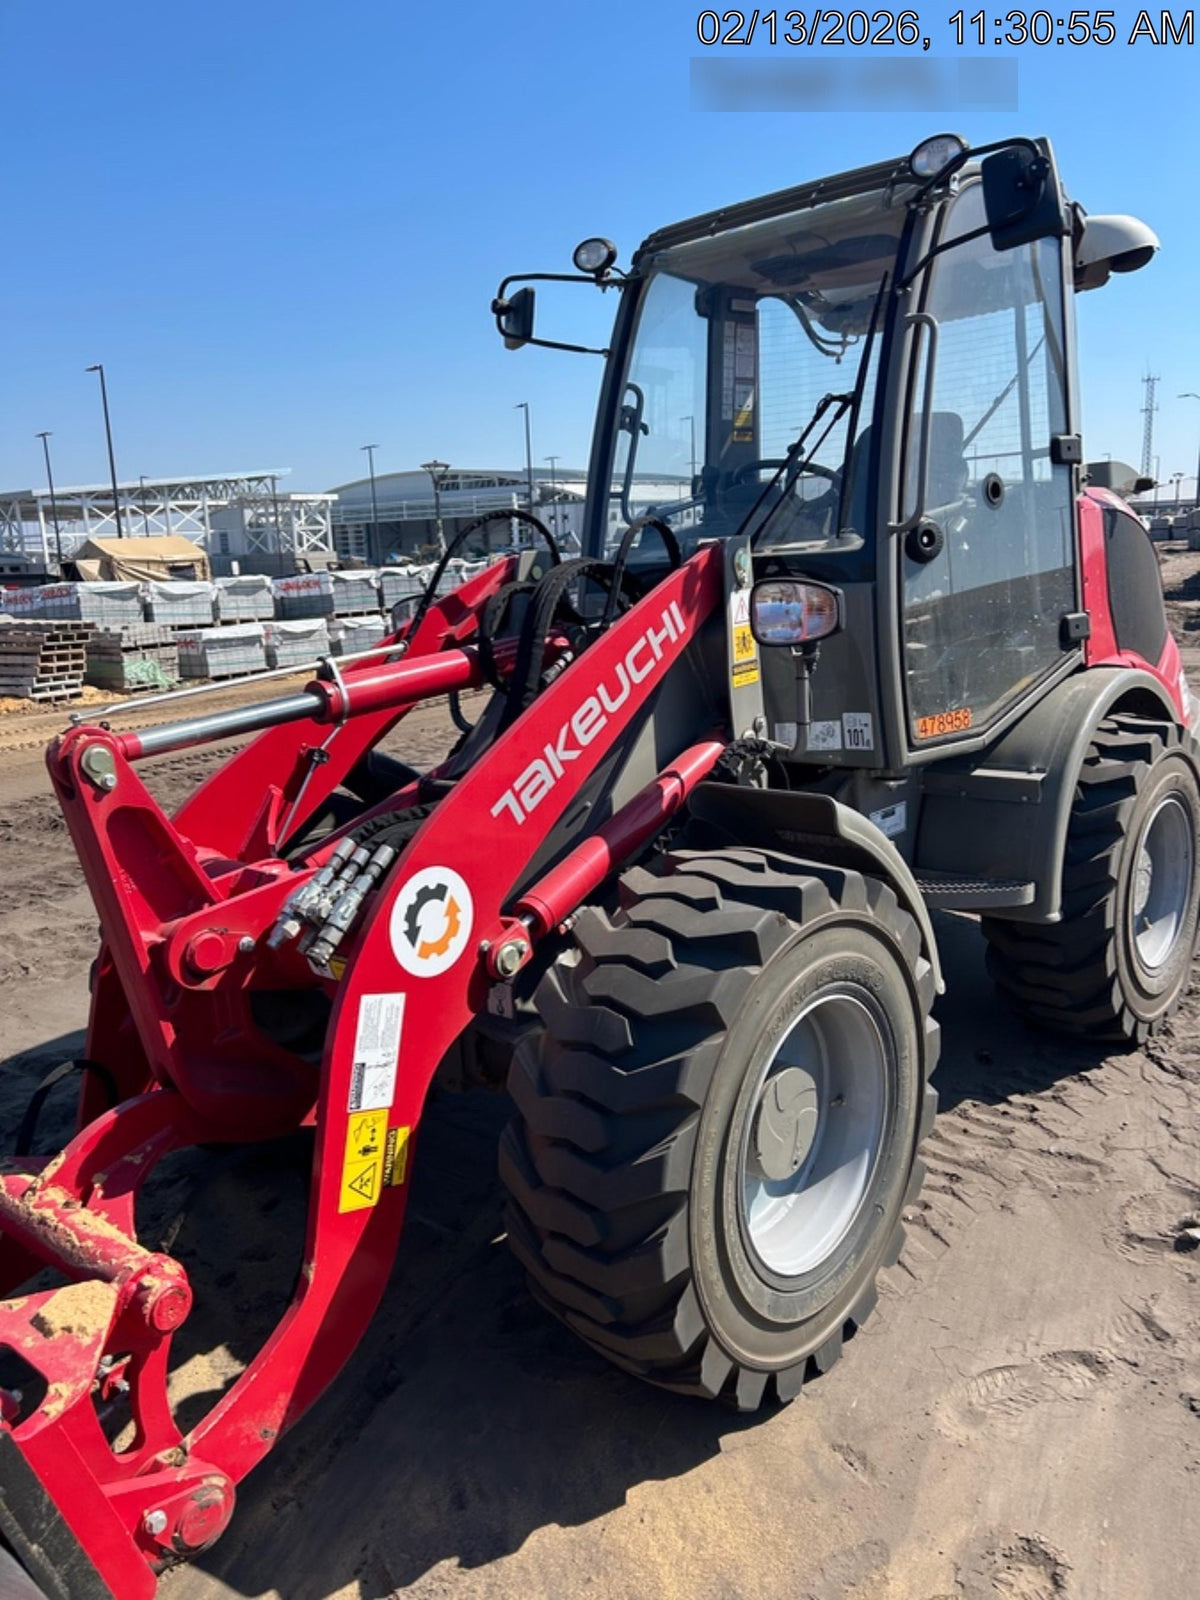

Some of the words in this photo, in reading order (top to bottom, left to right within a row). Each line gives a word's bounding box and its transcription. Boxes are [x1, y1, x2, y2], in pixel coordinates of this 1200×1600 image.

[490, 600, 686, 825] TAKEUCHI
[919, 708, 970, 735] 478958
[847, 728, 865, 747] 101
